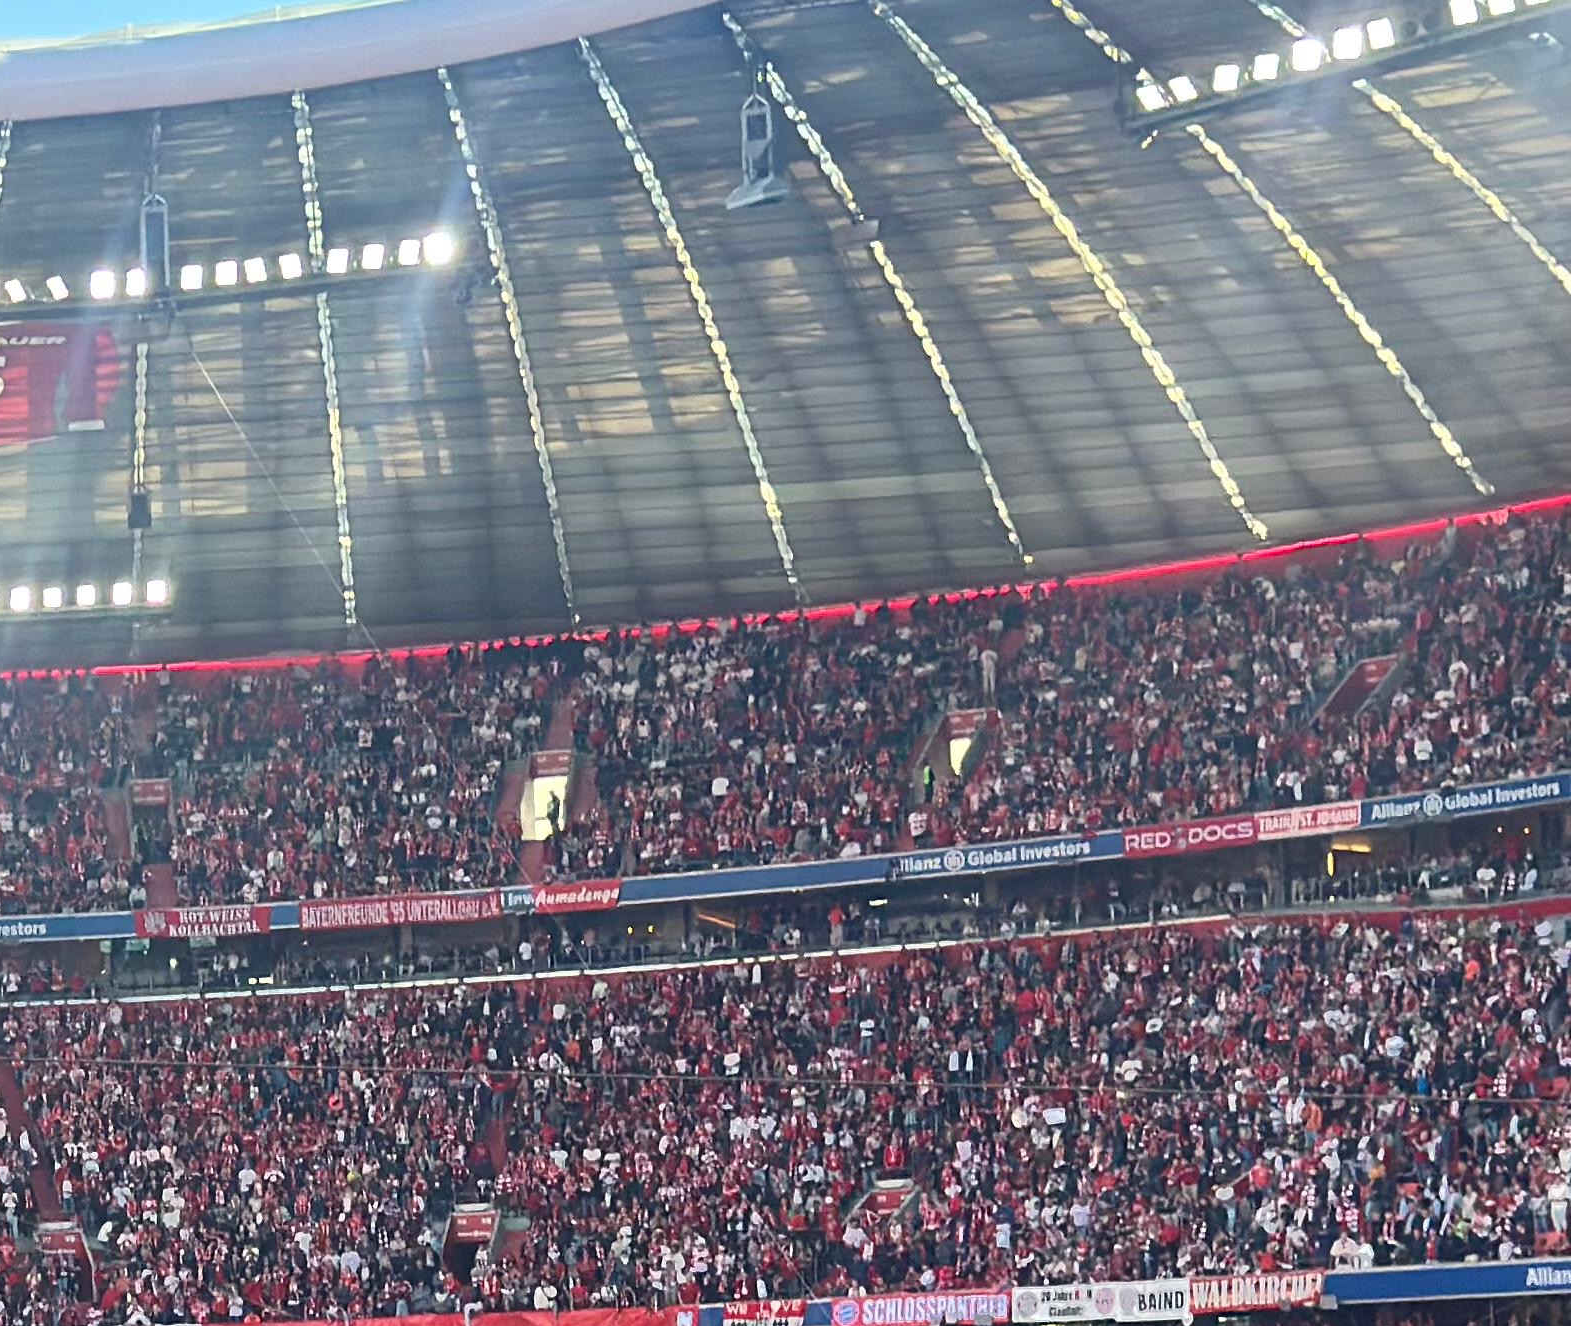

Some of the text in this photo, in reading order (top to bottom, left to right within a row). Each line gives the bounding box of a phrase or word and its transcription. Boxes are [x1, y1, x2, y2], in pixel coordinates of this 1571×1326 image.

[1444, 791, 1493, 811] Global
[1495, 782, 1560, 803] Investors
[1125, 819, 1254, 852] RED DOCS
[895, 840, 1091, 873] llianz Global Investors
[302, 902, 388, 928] BAYERNFREUNDE
[1526, 1266, 1571, 1287] Allian
